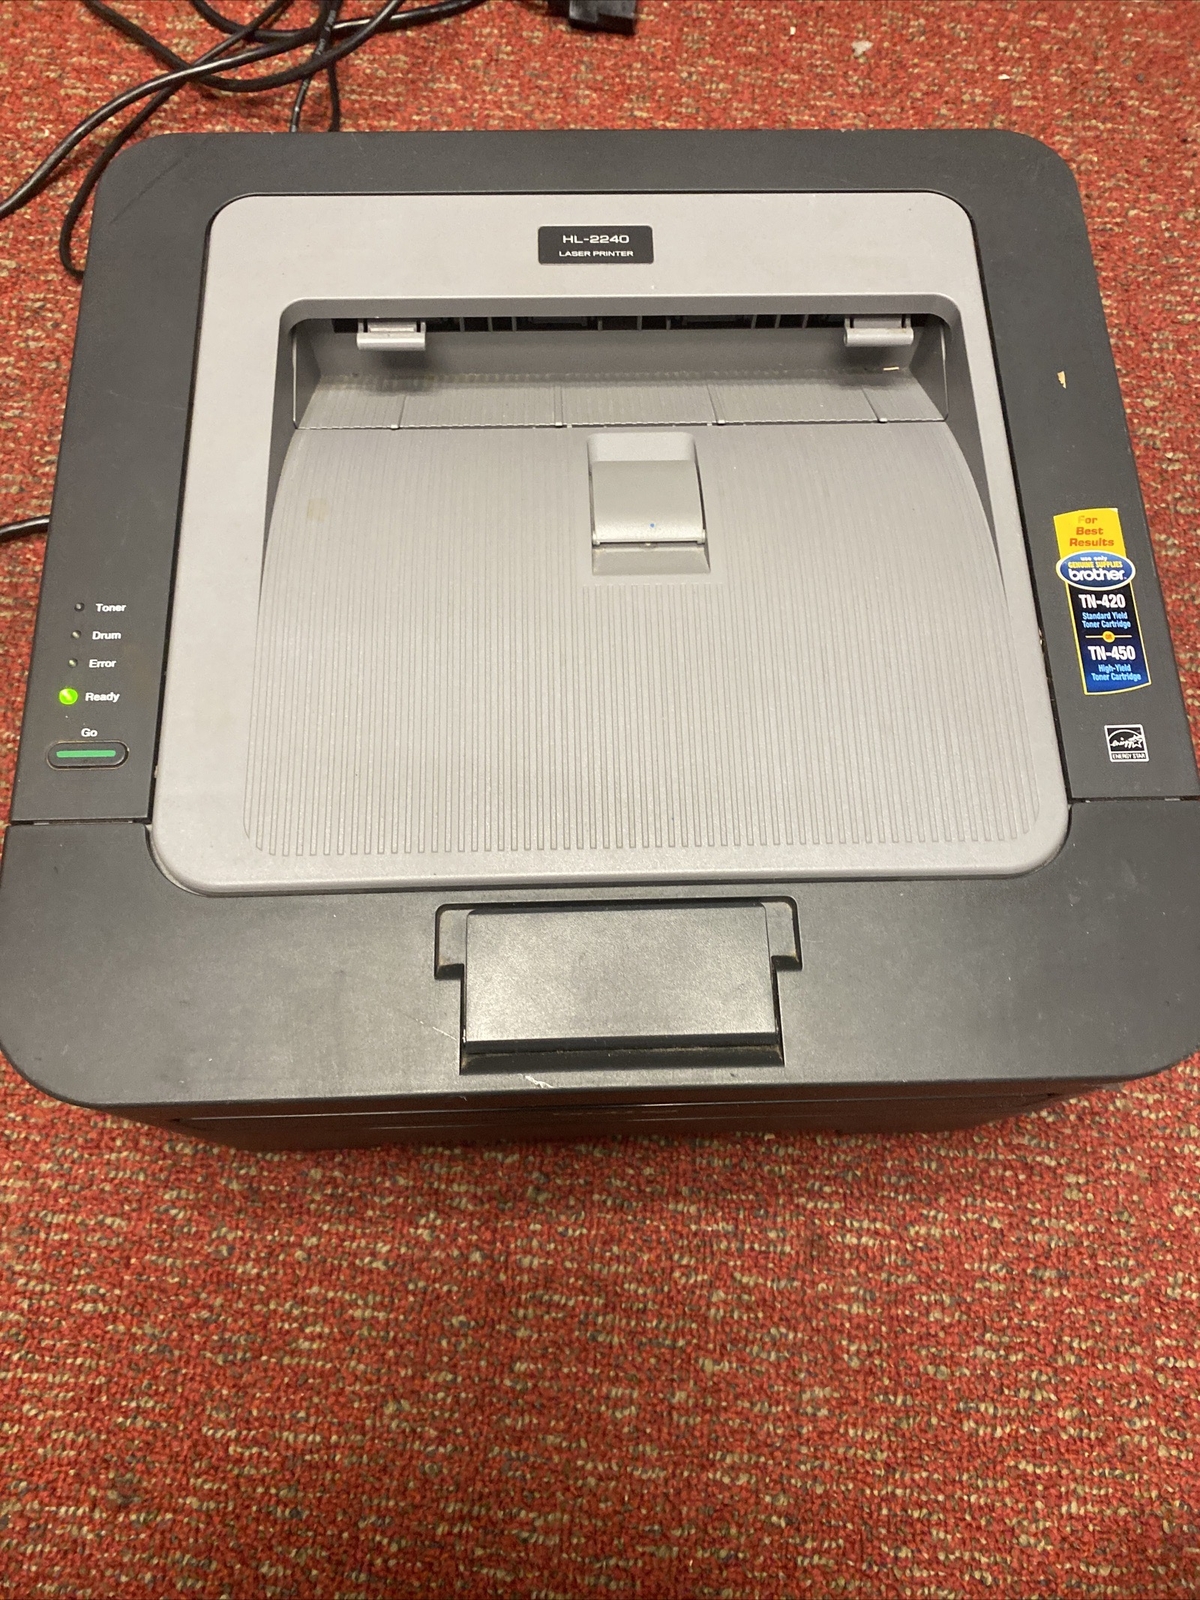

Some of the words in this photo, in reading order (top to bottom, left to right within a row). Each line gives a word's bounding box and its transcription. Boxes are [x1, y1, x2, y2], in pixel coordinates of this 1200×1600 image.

[562, 234, 630, 244] HL-2240
[1078, 515, 1098, 524] For
[1076, 526, 1104, 536] Best
[1069, 537, 1115, 547] Results
[1068, 568, 1124, 581] brother
[1078, 594, 1126, 609] TN-420
[95, 603, 127, 612] Toner
[1082, 612, 1112, 620] Standard
[1112, 612, 1128, 620] Yield
[1082, 620, 1100, 628] Toner
[1101, 620, 1131, 629] Cartridge
[92, 631, 122, 640] Drum
[1087, 645, 1136, 661] TN-450
[88, 659, 117, 668] Error
[1098, 664, 1132, 673] High-Yield
[1091, 673, 1110, 681] Toner
[1110, 673, 1142, 682] Cartridge
[85, 692, 120, 703] Ready
[81, 728, 98, 737] Go
